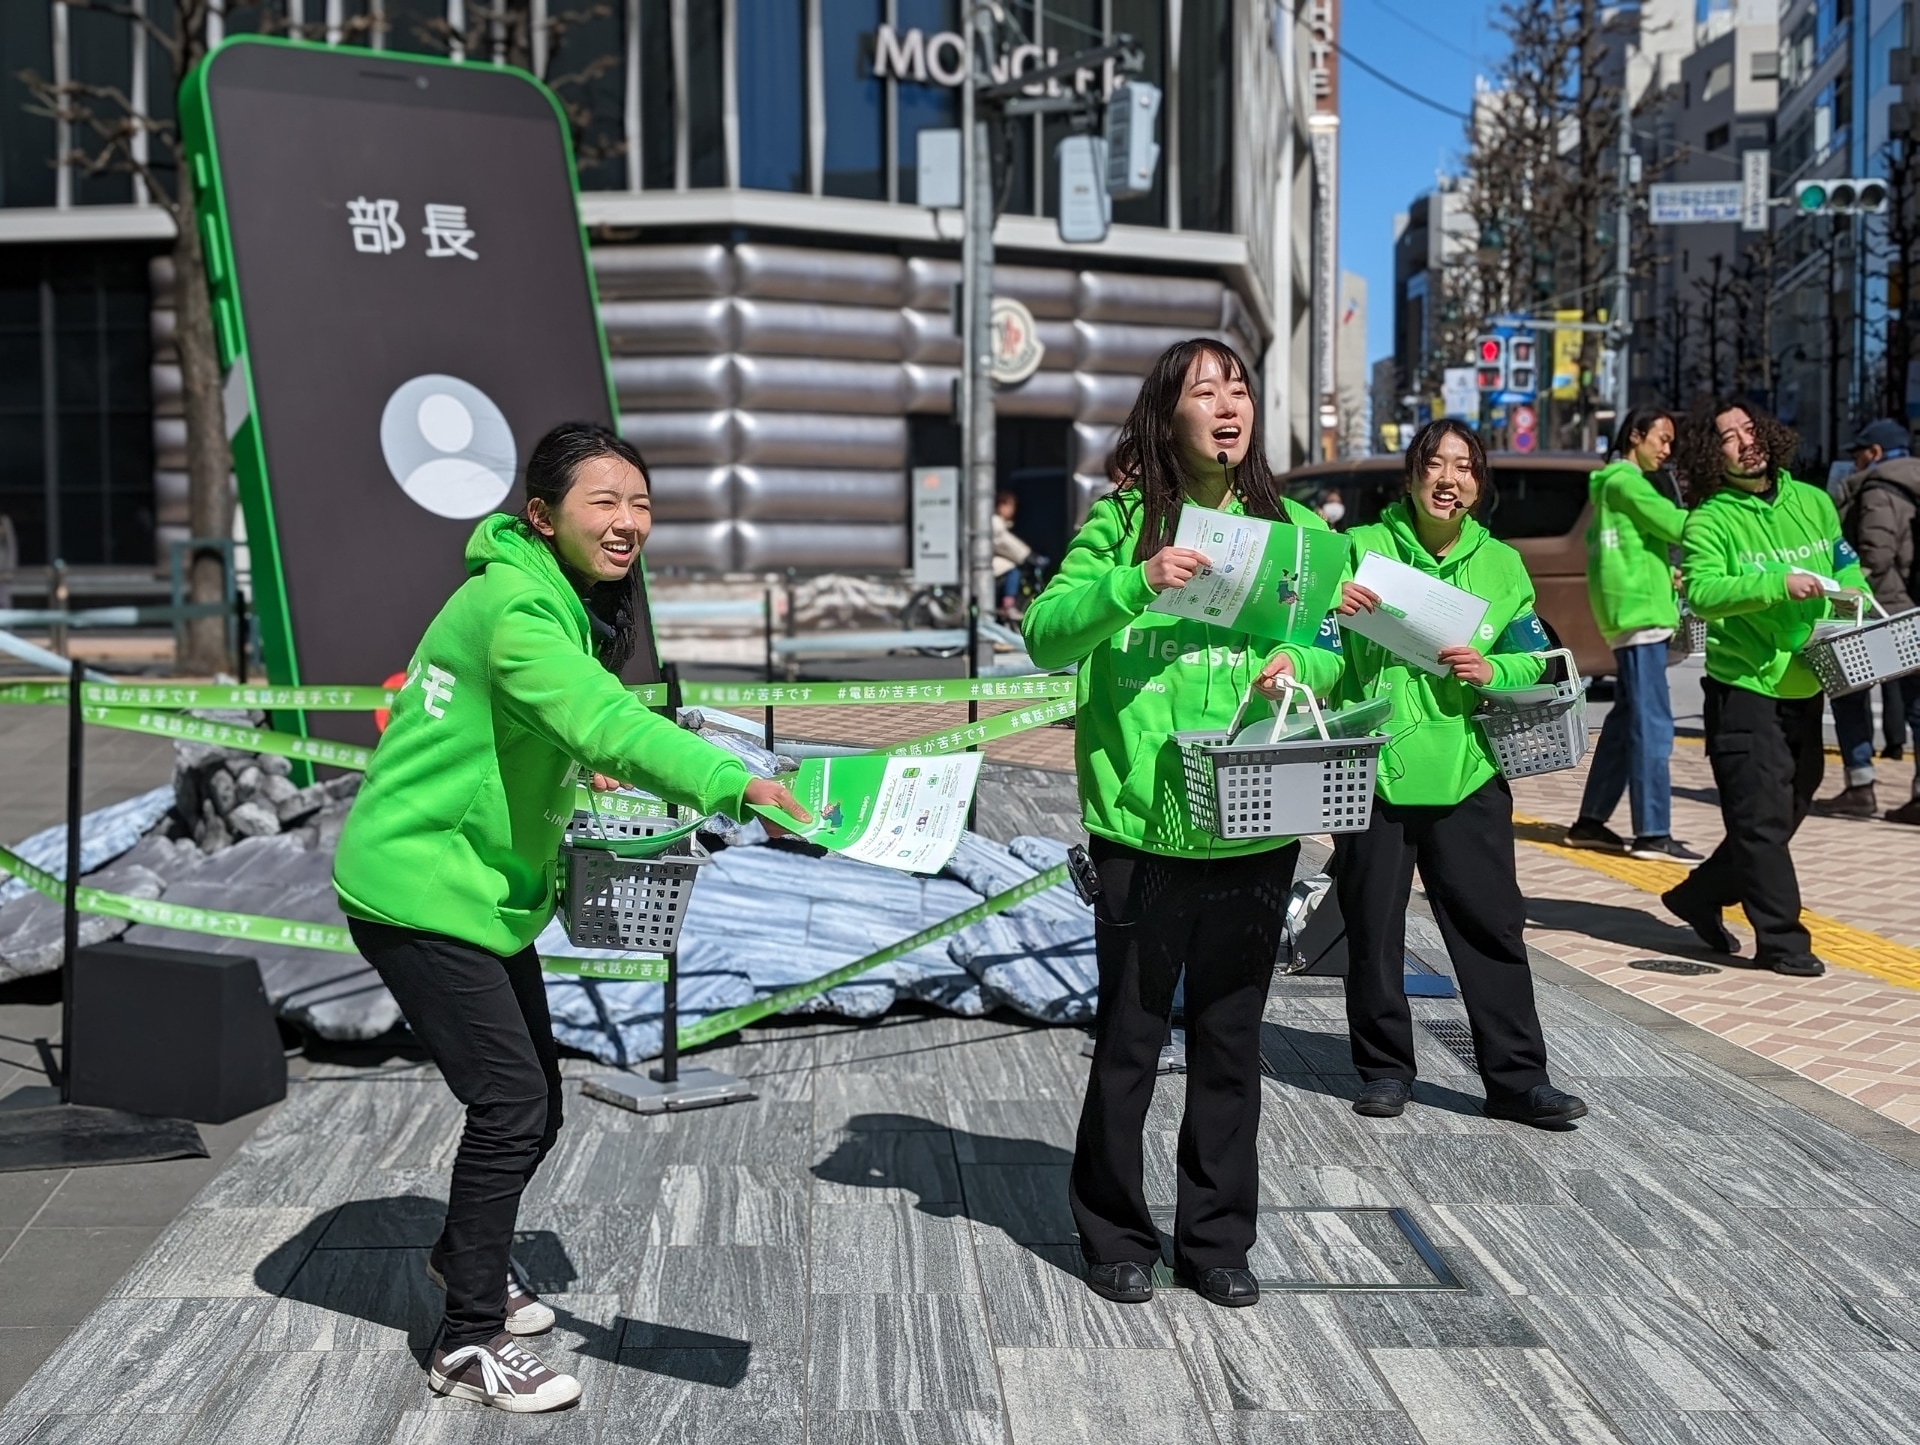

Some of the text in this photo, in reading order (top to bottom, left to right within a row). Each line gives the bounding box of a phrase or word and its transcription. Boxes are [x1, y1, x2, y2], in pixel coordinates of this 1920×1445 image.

[701, 680, 1073, 702] #電話が苦手です #電話が苦手です #電話が苦手です
[1117, 676, 1166, 693] LINEMO
[230, 689, 354, 705] #電話が苦手です
